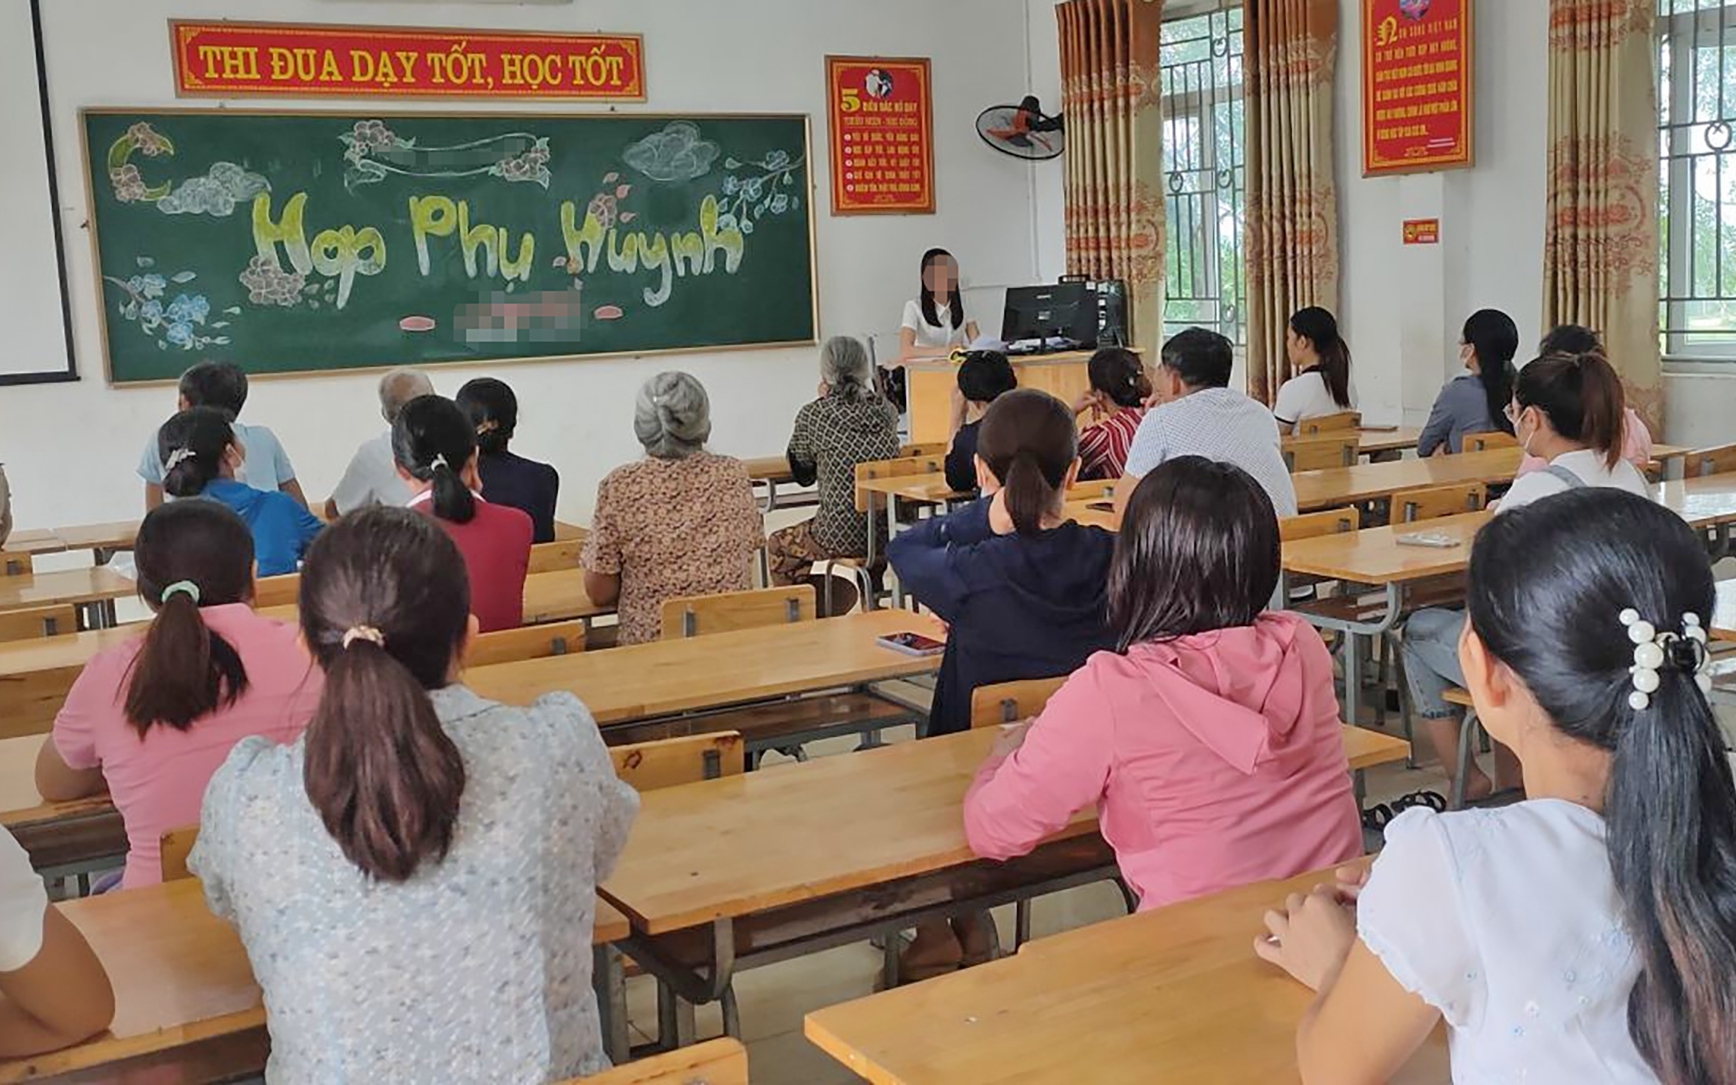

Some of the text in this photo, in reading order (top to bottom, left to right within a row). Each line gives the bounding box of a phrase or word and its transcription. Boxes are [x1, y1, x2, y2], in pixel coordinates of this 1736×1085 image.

[198, 41, 623, 90] THI ĐUA DẠY TỐT, HỌC TỐT
[841, 88, 860, 112] 5
[561, 194, 744, 307] Huynh
